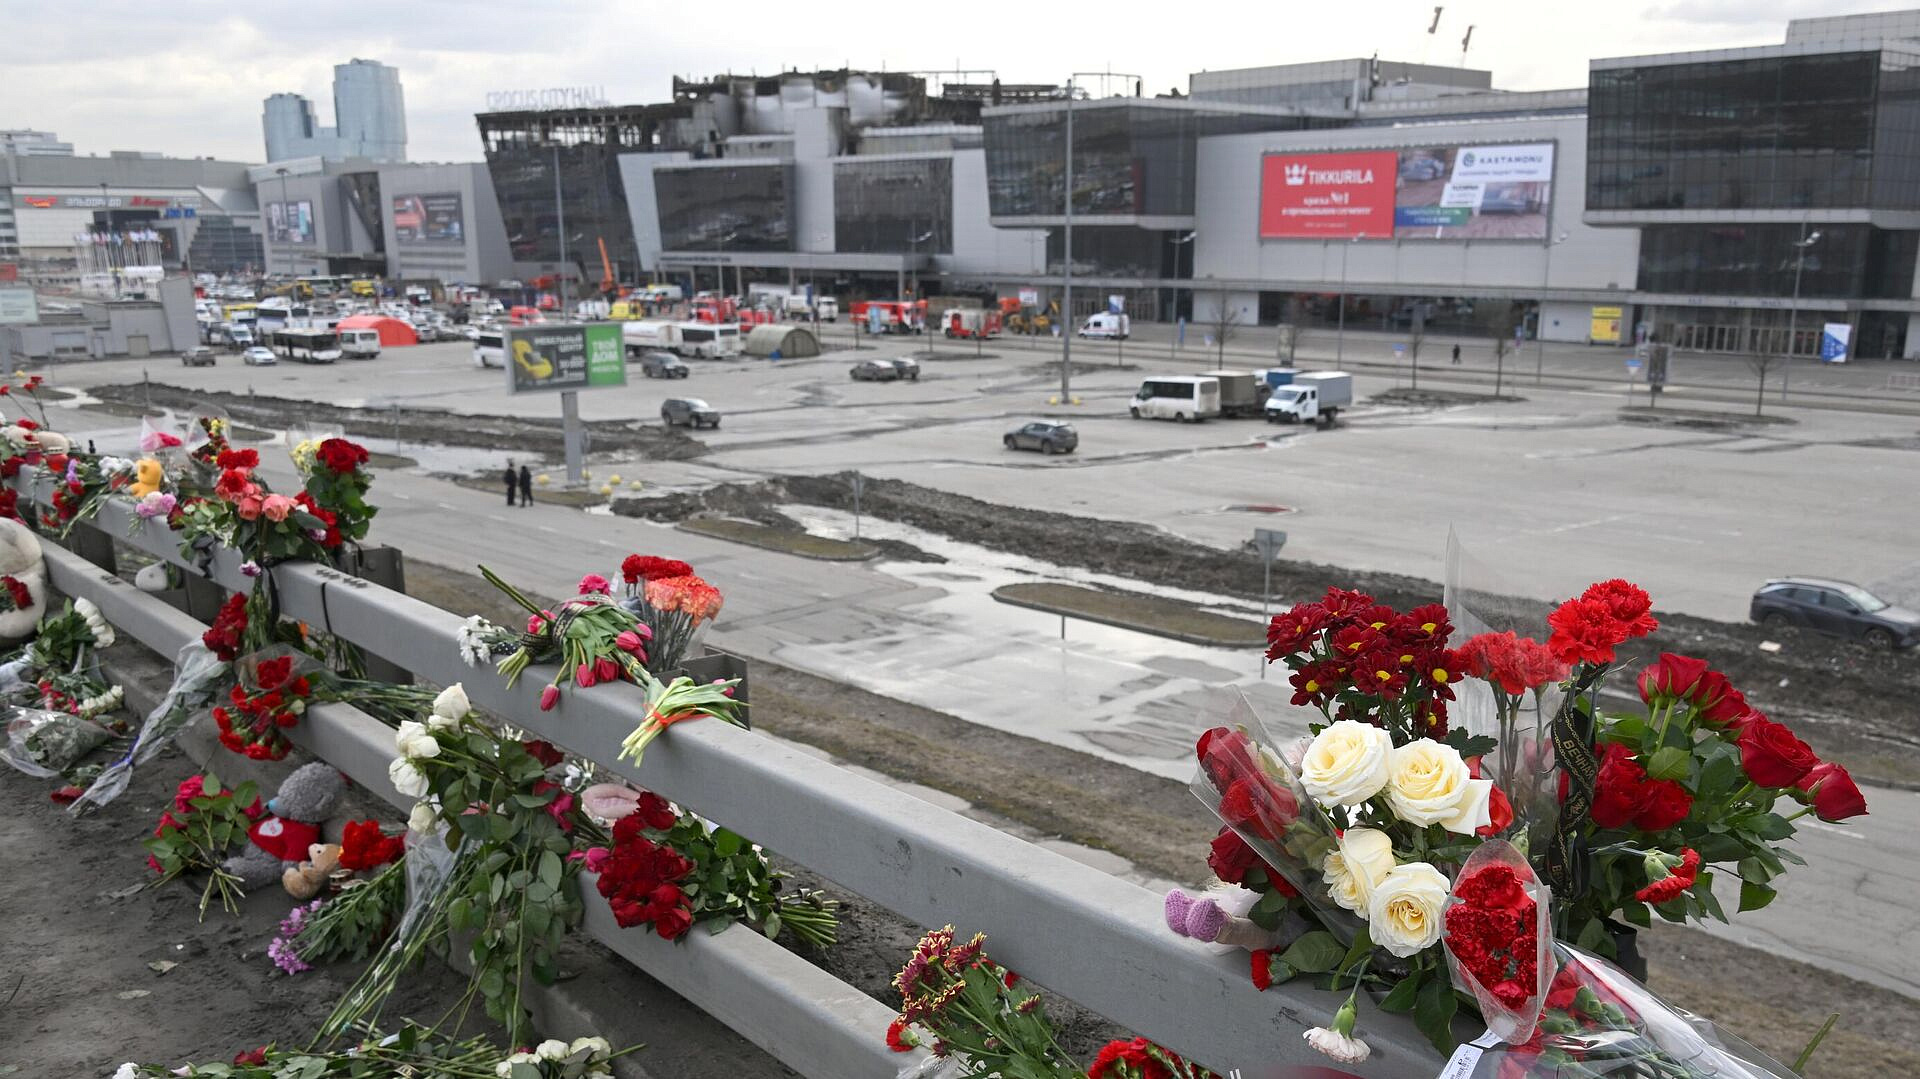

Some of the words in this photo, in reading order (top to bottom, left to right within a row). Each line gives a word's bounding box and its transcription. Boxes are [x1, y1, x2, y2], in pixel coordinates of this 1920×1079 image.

[486, 89, 537, 108] CROCUS
[539, 87, 570, 107] CITY
[571, 84, 605, 105] HALL
[1308, 169, 1374, 185] TIKKURILA
[592, 338, 618, 352] ТВОЙ
[591, 351, 619, 363] ДОМ
[1562, 739, 1596, 779] ВЕЧНАЯ
